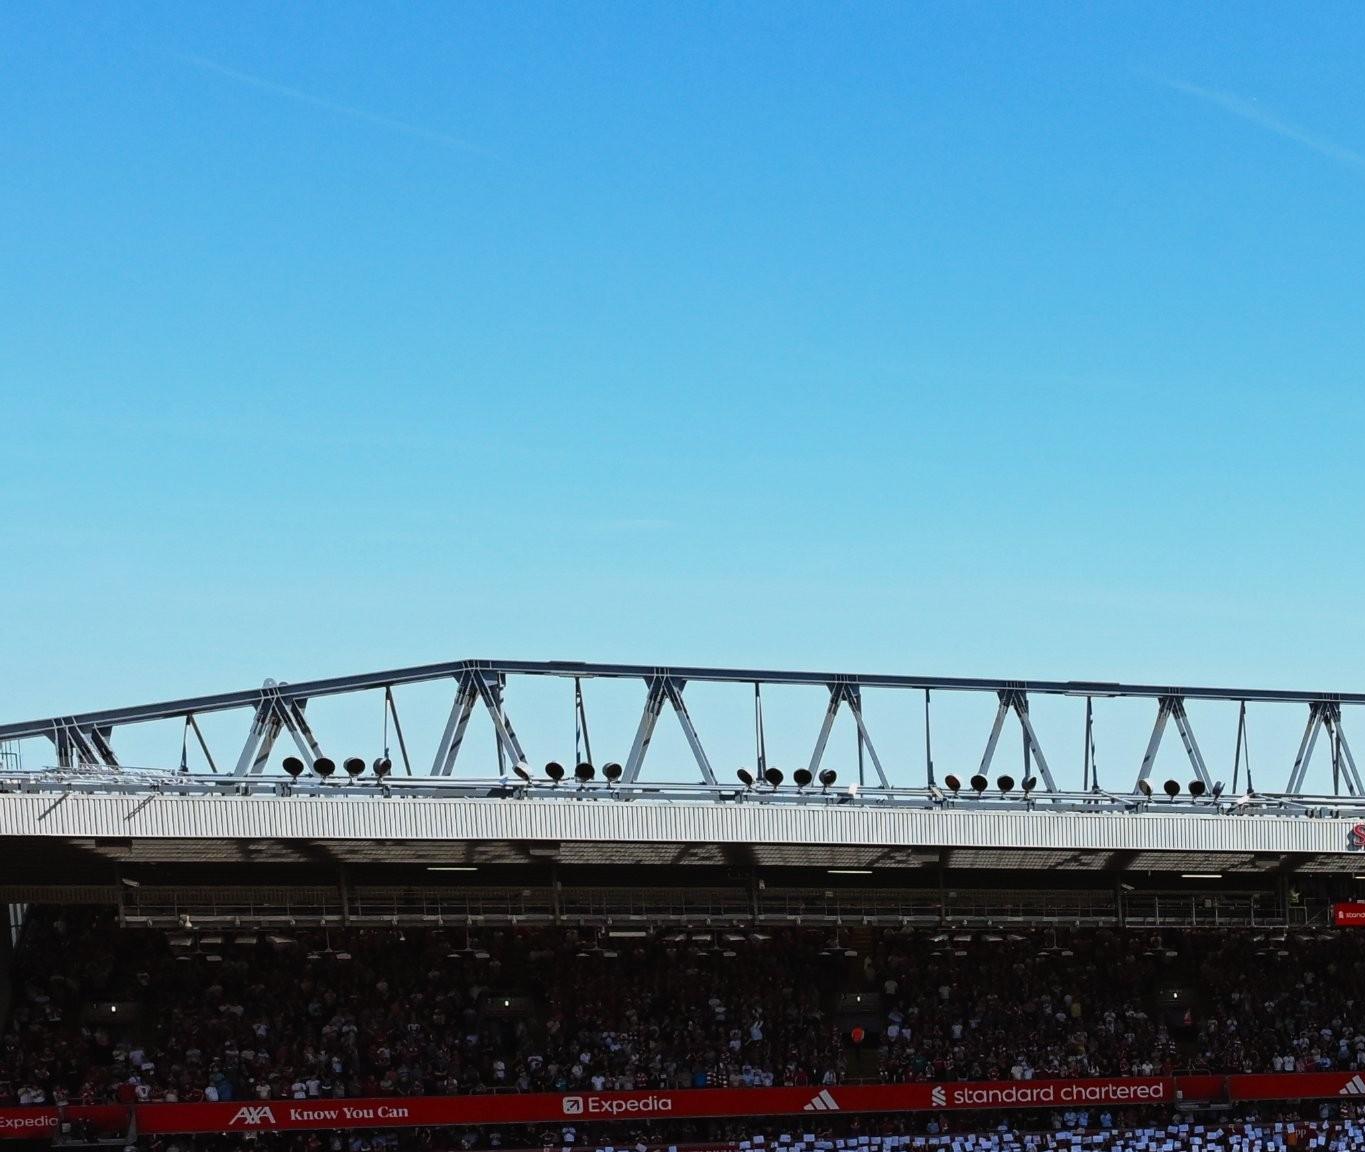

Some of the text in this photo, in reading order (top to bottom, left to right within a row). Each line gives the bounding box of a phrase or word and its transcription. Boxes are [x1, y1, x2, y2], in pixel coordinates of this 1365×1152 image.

[954, 1082, 1164, 1104] standard chartered
[589, 1096, 672, 1115] Expedia
[228, 1106, 409, 1125] AXA Know You Can
